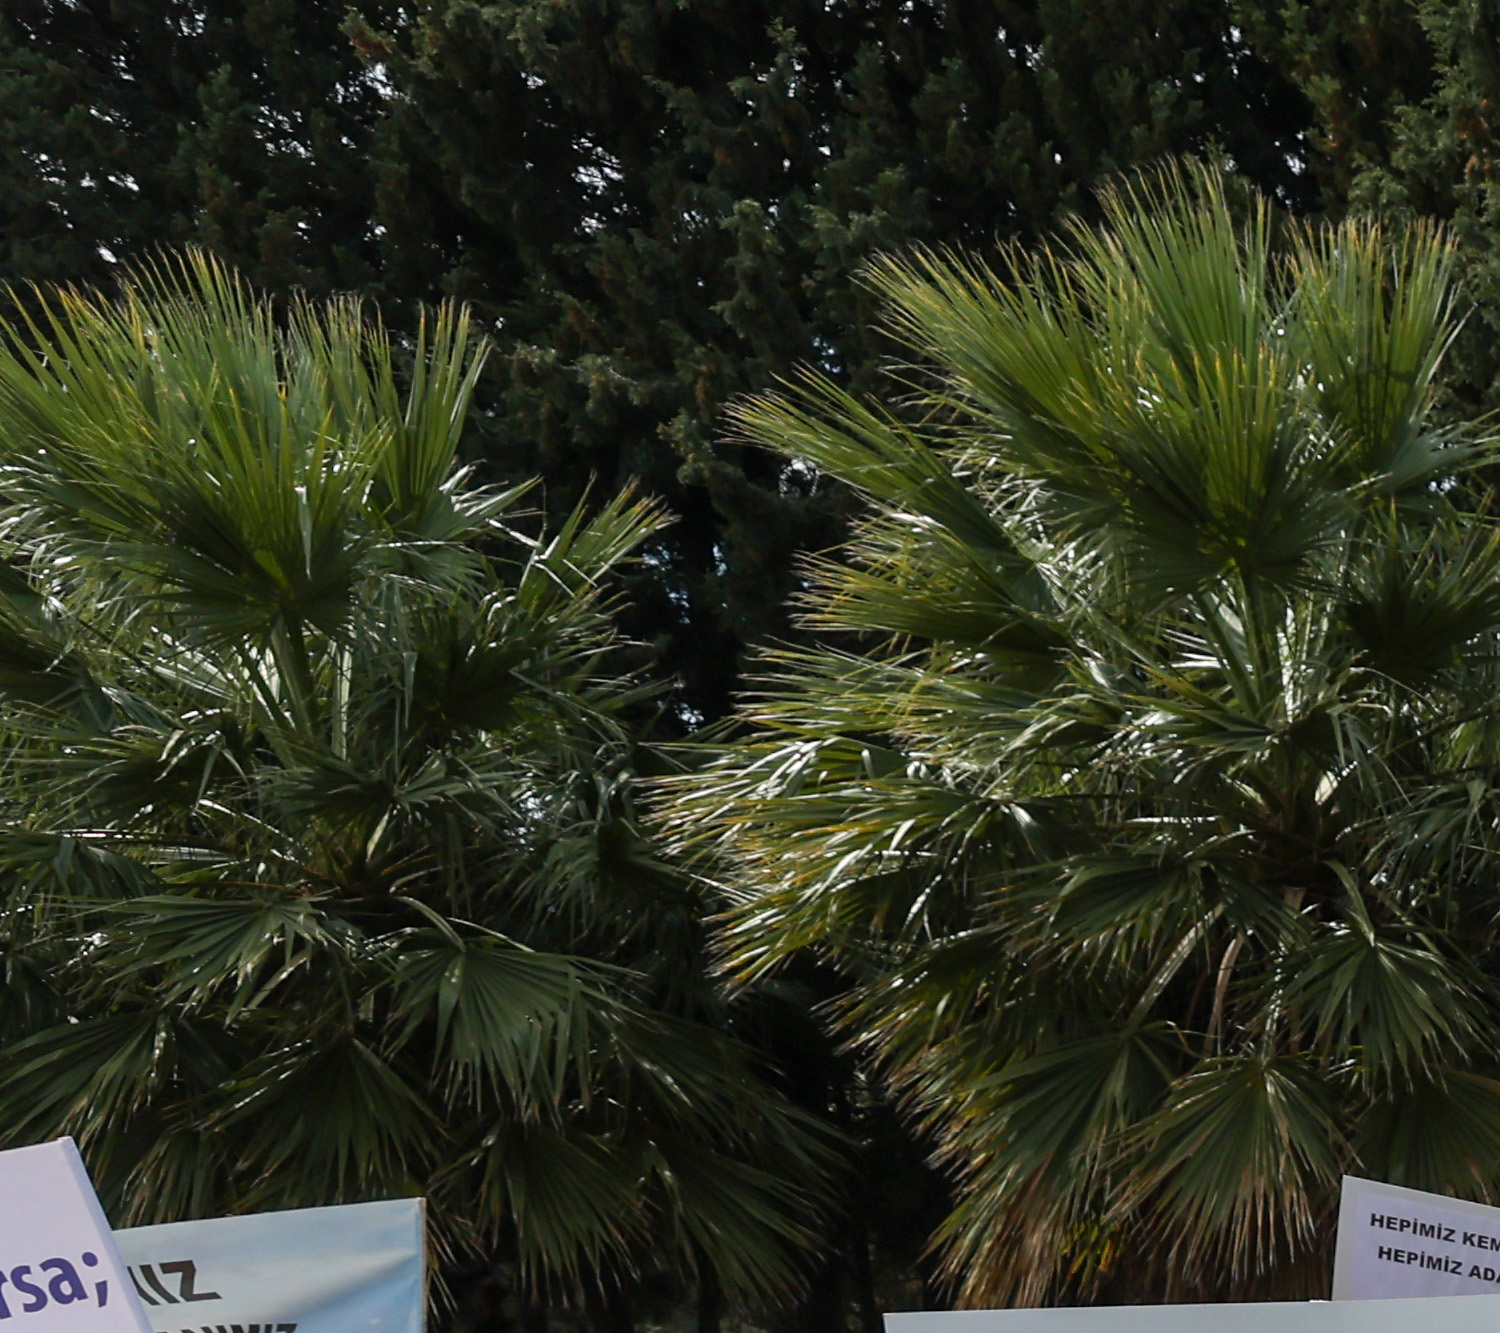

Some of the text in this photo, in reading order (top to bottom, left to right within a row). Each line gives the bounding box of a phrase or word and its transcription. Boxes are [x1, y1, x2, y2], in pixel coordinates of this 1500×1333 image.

[1370, 1213, 1456, 1242] HEPİMİZ
[1378, 1246, 1463, 1275] HEPİMİZ
[127, 1260, 222, 1306] IZ
